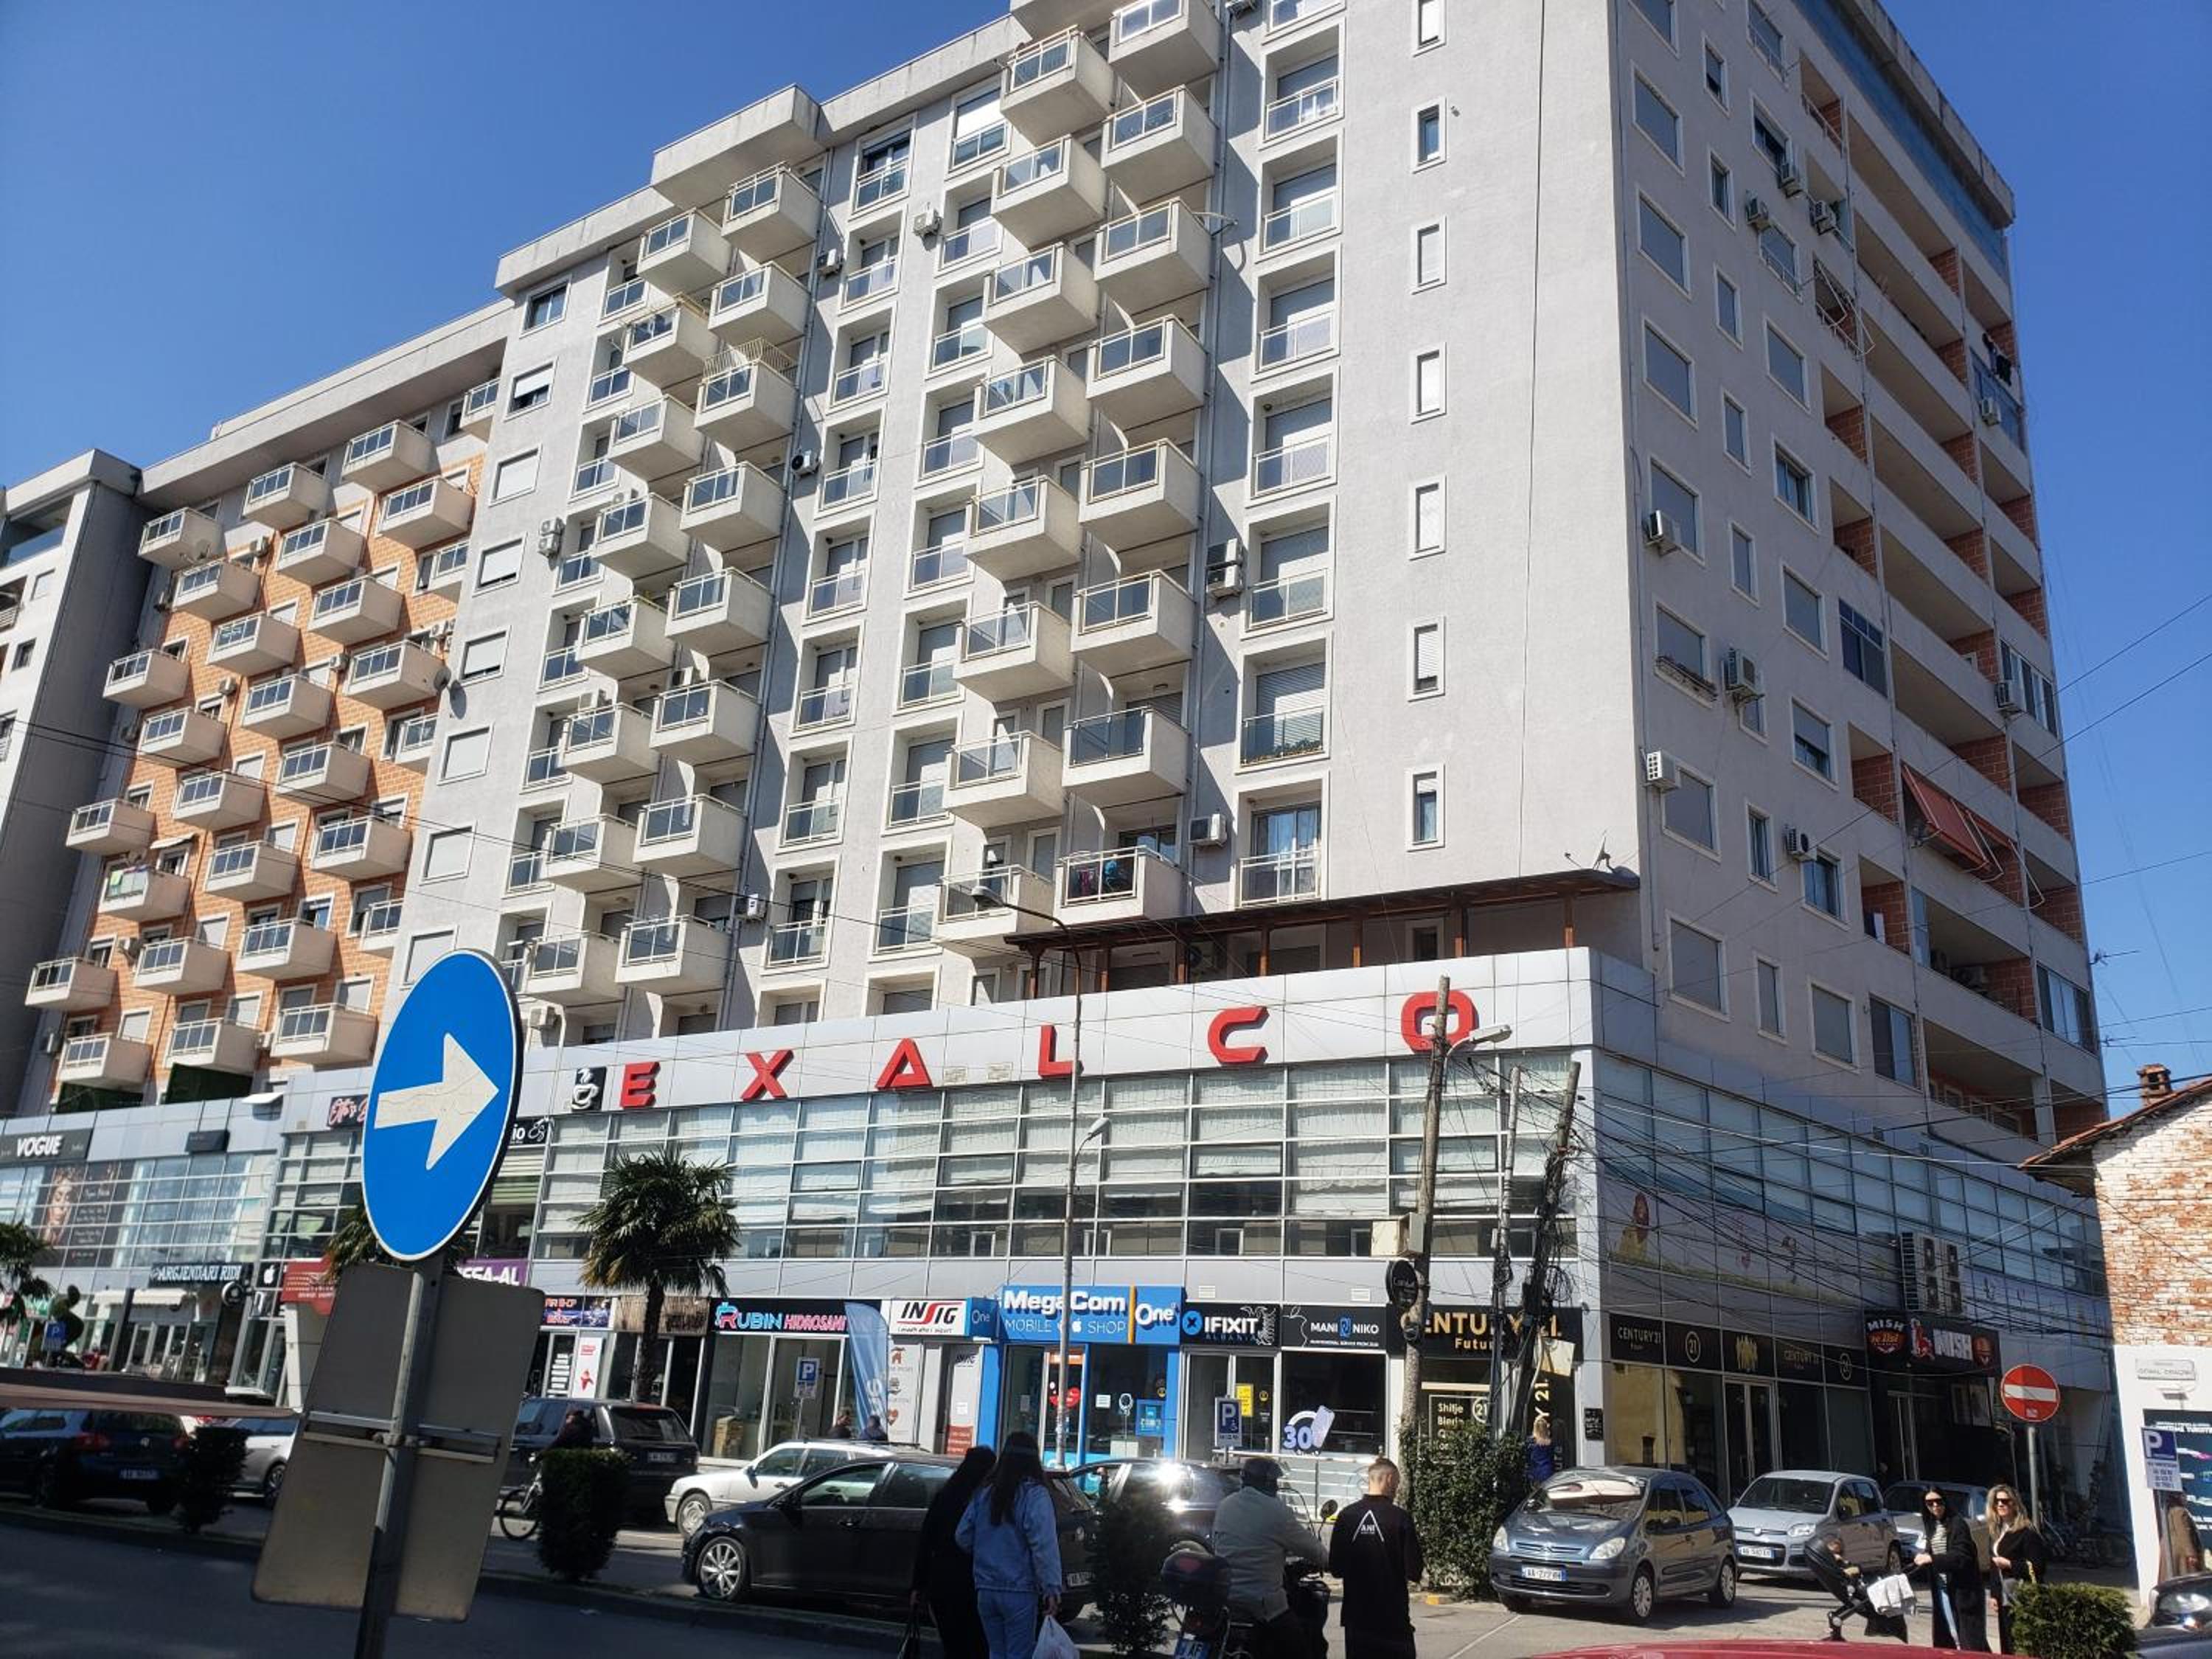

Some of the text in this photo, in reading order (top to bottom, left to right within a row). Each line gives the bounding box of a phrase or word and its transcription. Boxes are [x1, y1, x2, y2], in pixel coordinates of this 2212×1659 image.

[619, 989, 1479, 1110] EXALCO
[17, 1135, 63, 1158] VOGUE
[901, 1302, 959, 1325] INSIG
[971, 1310, 990, 1324] One
[1135, 1303, 1174, 1326] One
[1205, 1316, 1259, 1334] IFIXIT
[1005, 1318, 1126, 1334] MOBILE SHOP
[1310, 1322, 1380, 1334] MANI NIKO
[1867, 1319, 1904, 1332] MISH
[802, 1363, 815, 1379] P
[1222, 1403, 1236, 1426] P
[1283, 1426, 1312, 1450] 30
[2143, 1430, 2163, 1457] P
